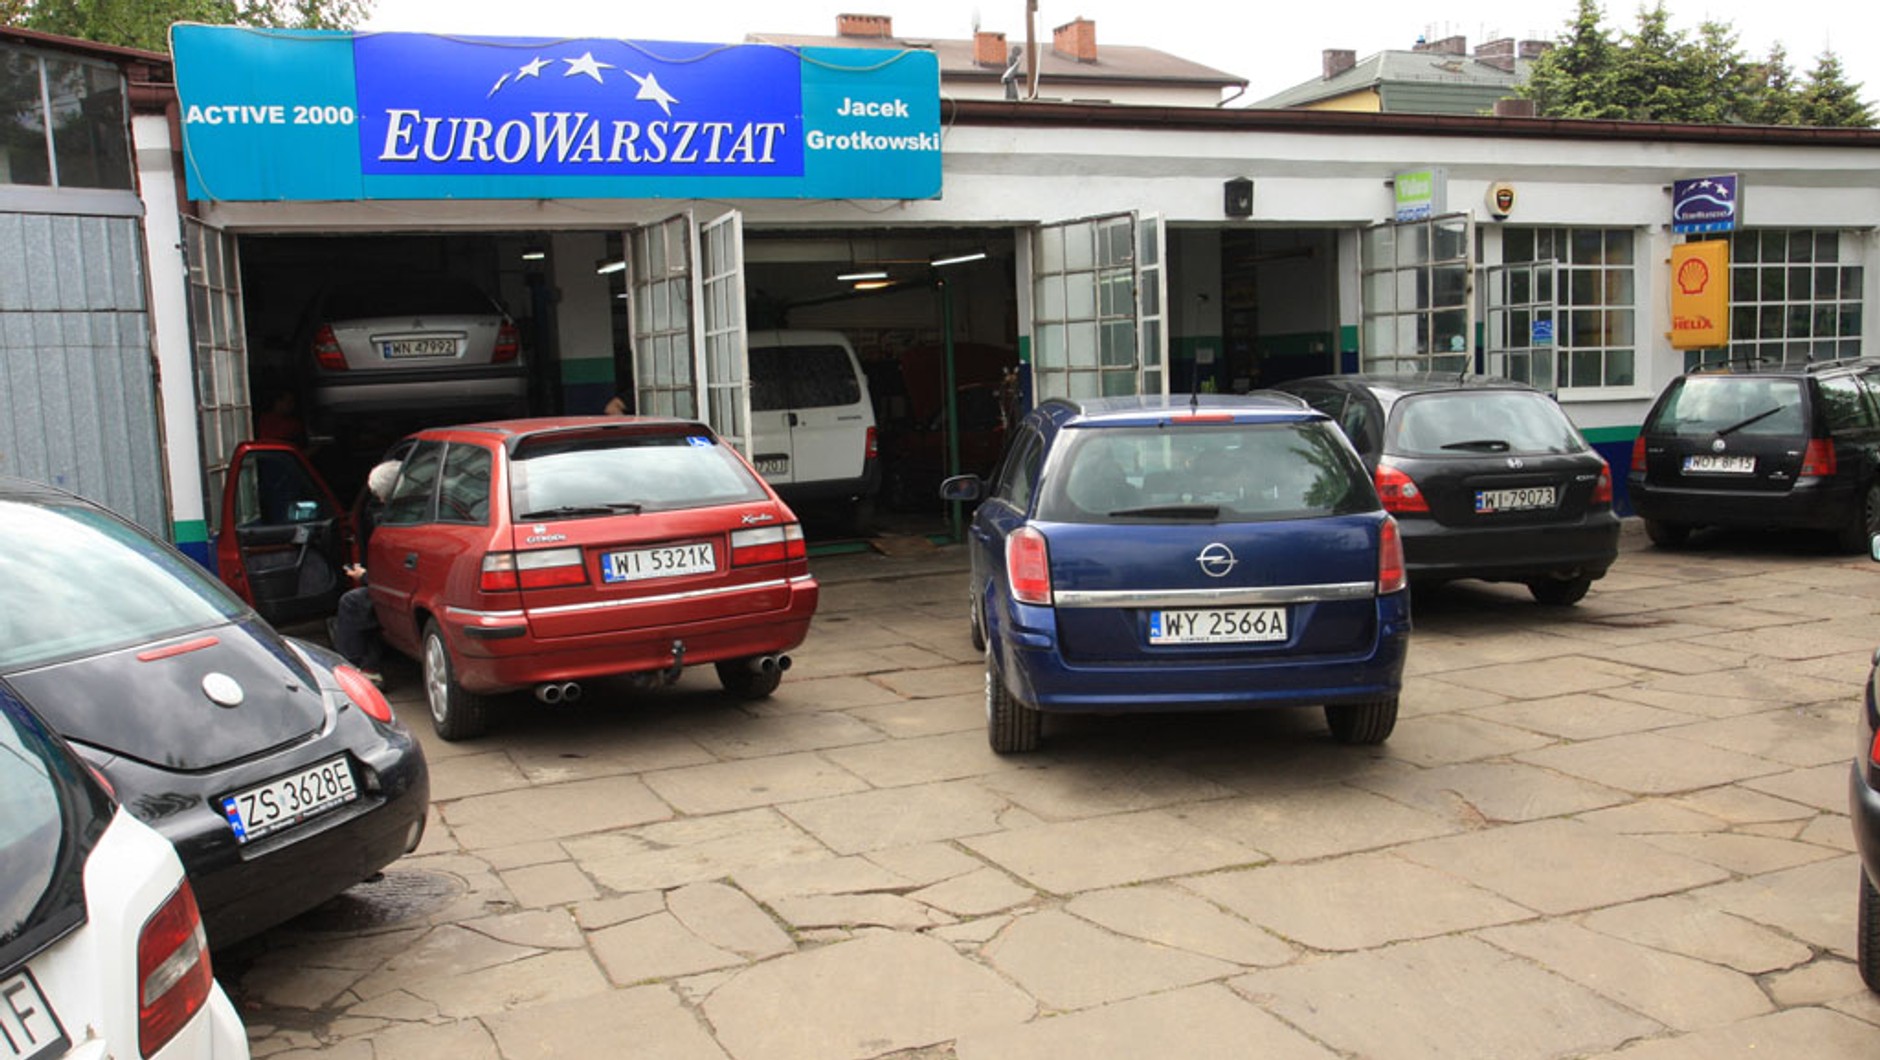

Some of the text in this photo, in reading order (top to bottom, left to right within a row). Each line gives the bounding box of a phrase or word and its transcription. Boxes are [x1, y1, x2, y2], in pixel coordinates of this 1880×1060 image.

[186, 105, 355, 125] ACTIVE 2000
[837, 97, 909, 118] Jacek
[806, 130, 940, 151] Grotkowski
[392, 342, 411, 354] WN
[1510, 489, 1553, 506] 79073
[614, 554, 642, 576] WI
[651, 545, 711, 569] 5321K
[1165, 611, 1283, 635] WY 2566A
[240, 788, 280, 827] ZS
[283, 762, 352, 811] 3628E
